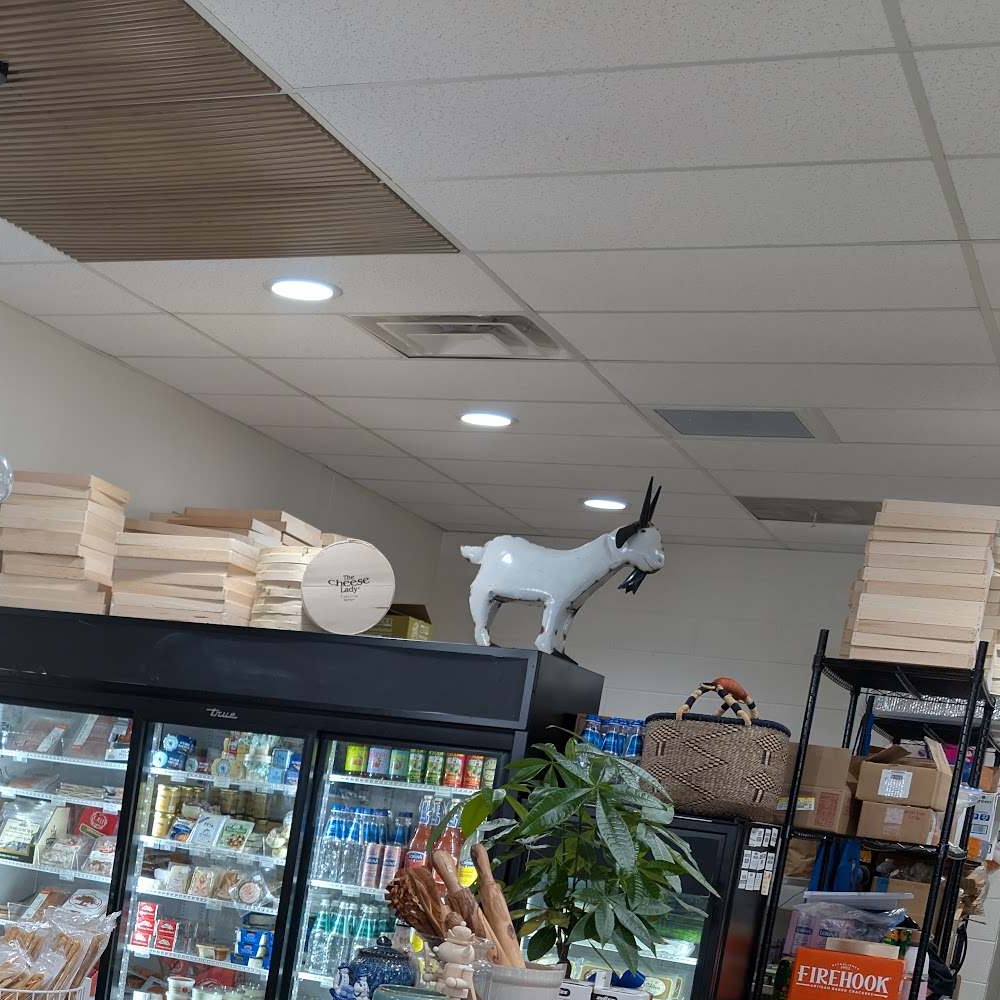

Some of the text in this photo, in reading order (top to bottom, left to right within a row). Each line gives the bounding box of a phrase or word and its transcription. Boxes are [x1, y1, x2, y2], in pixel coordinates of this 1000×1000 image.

[327, 577, 371, 587] Cheese
[206, 707, 238, 719] true
[831, 963, 860, 971] ESTABLISHED
[798, 965, 890, 994] FIREHOOK
[848, 989, 875, 997] CRACKERS
